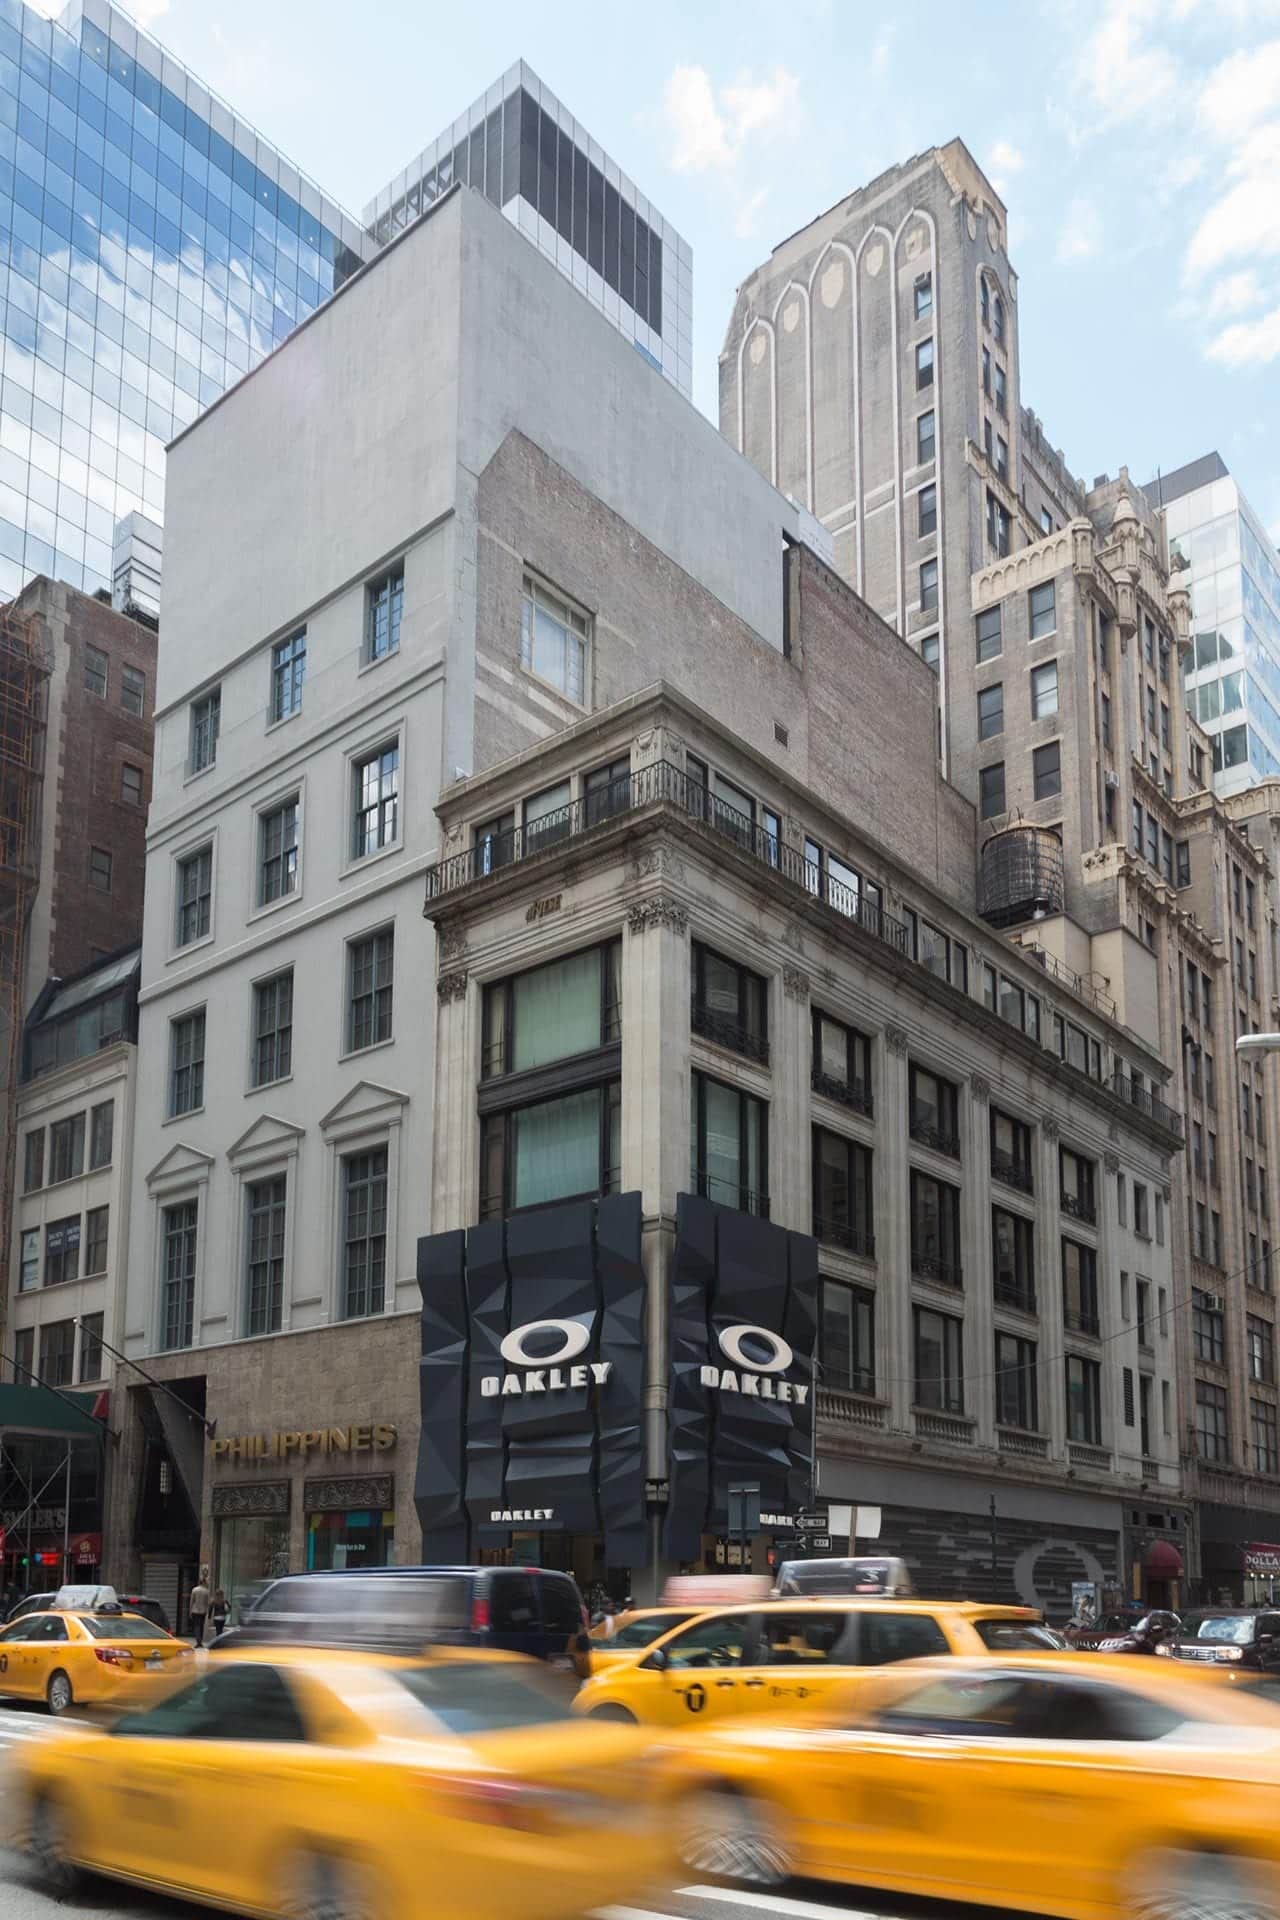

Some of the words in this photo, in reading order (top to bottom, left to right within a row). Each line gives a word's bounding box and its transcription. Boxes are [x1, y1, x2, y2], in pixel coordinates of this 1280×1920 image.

[481, 1362, 612, 1397] OAKLEY
[700, 1365, 809, 1405] OAKLEY
[209, 1423, 398, 1457] PHILIPPINES
[490, 1509, 554, 1521] OAKLEY
[760, 1513, 793, 1526] OAKL
[1245, 1555, 1280, 1567] DOLLA
